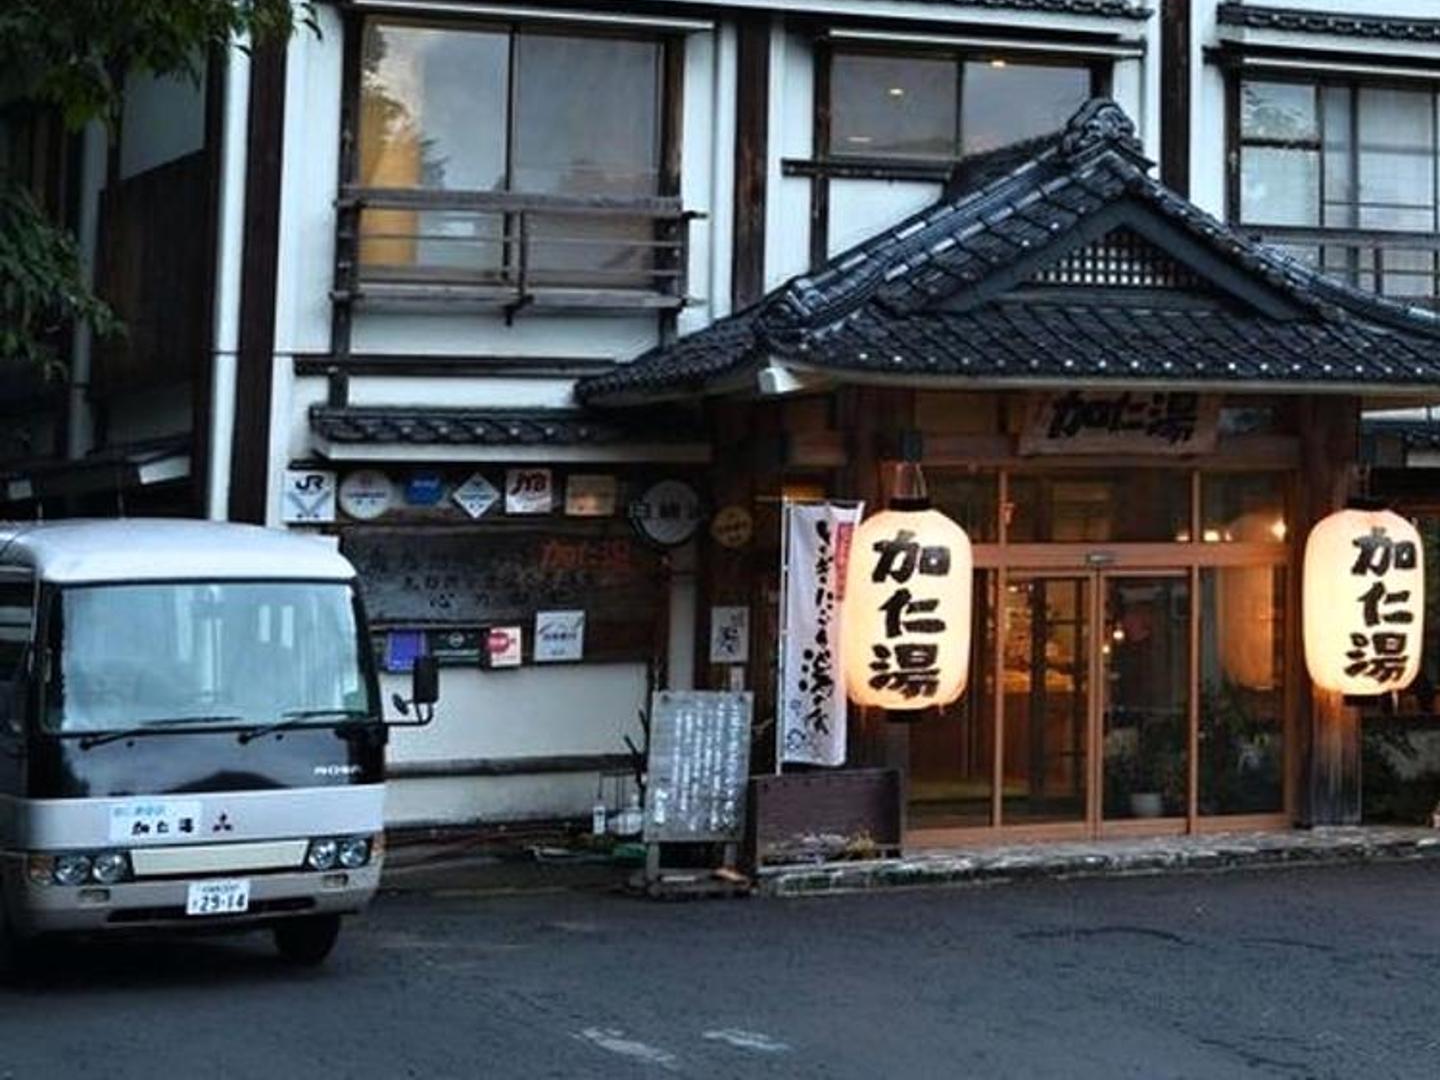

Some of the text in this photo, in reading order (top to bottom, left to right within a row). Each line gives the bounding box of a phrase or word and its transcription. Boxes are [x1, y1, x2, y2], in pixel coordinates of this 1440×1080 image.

[296, 475, 324, 490] JR
[868, 530, 951, 699] 加仁湯
[1344, 526, 1417, 683] 加仁湯
